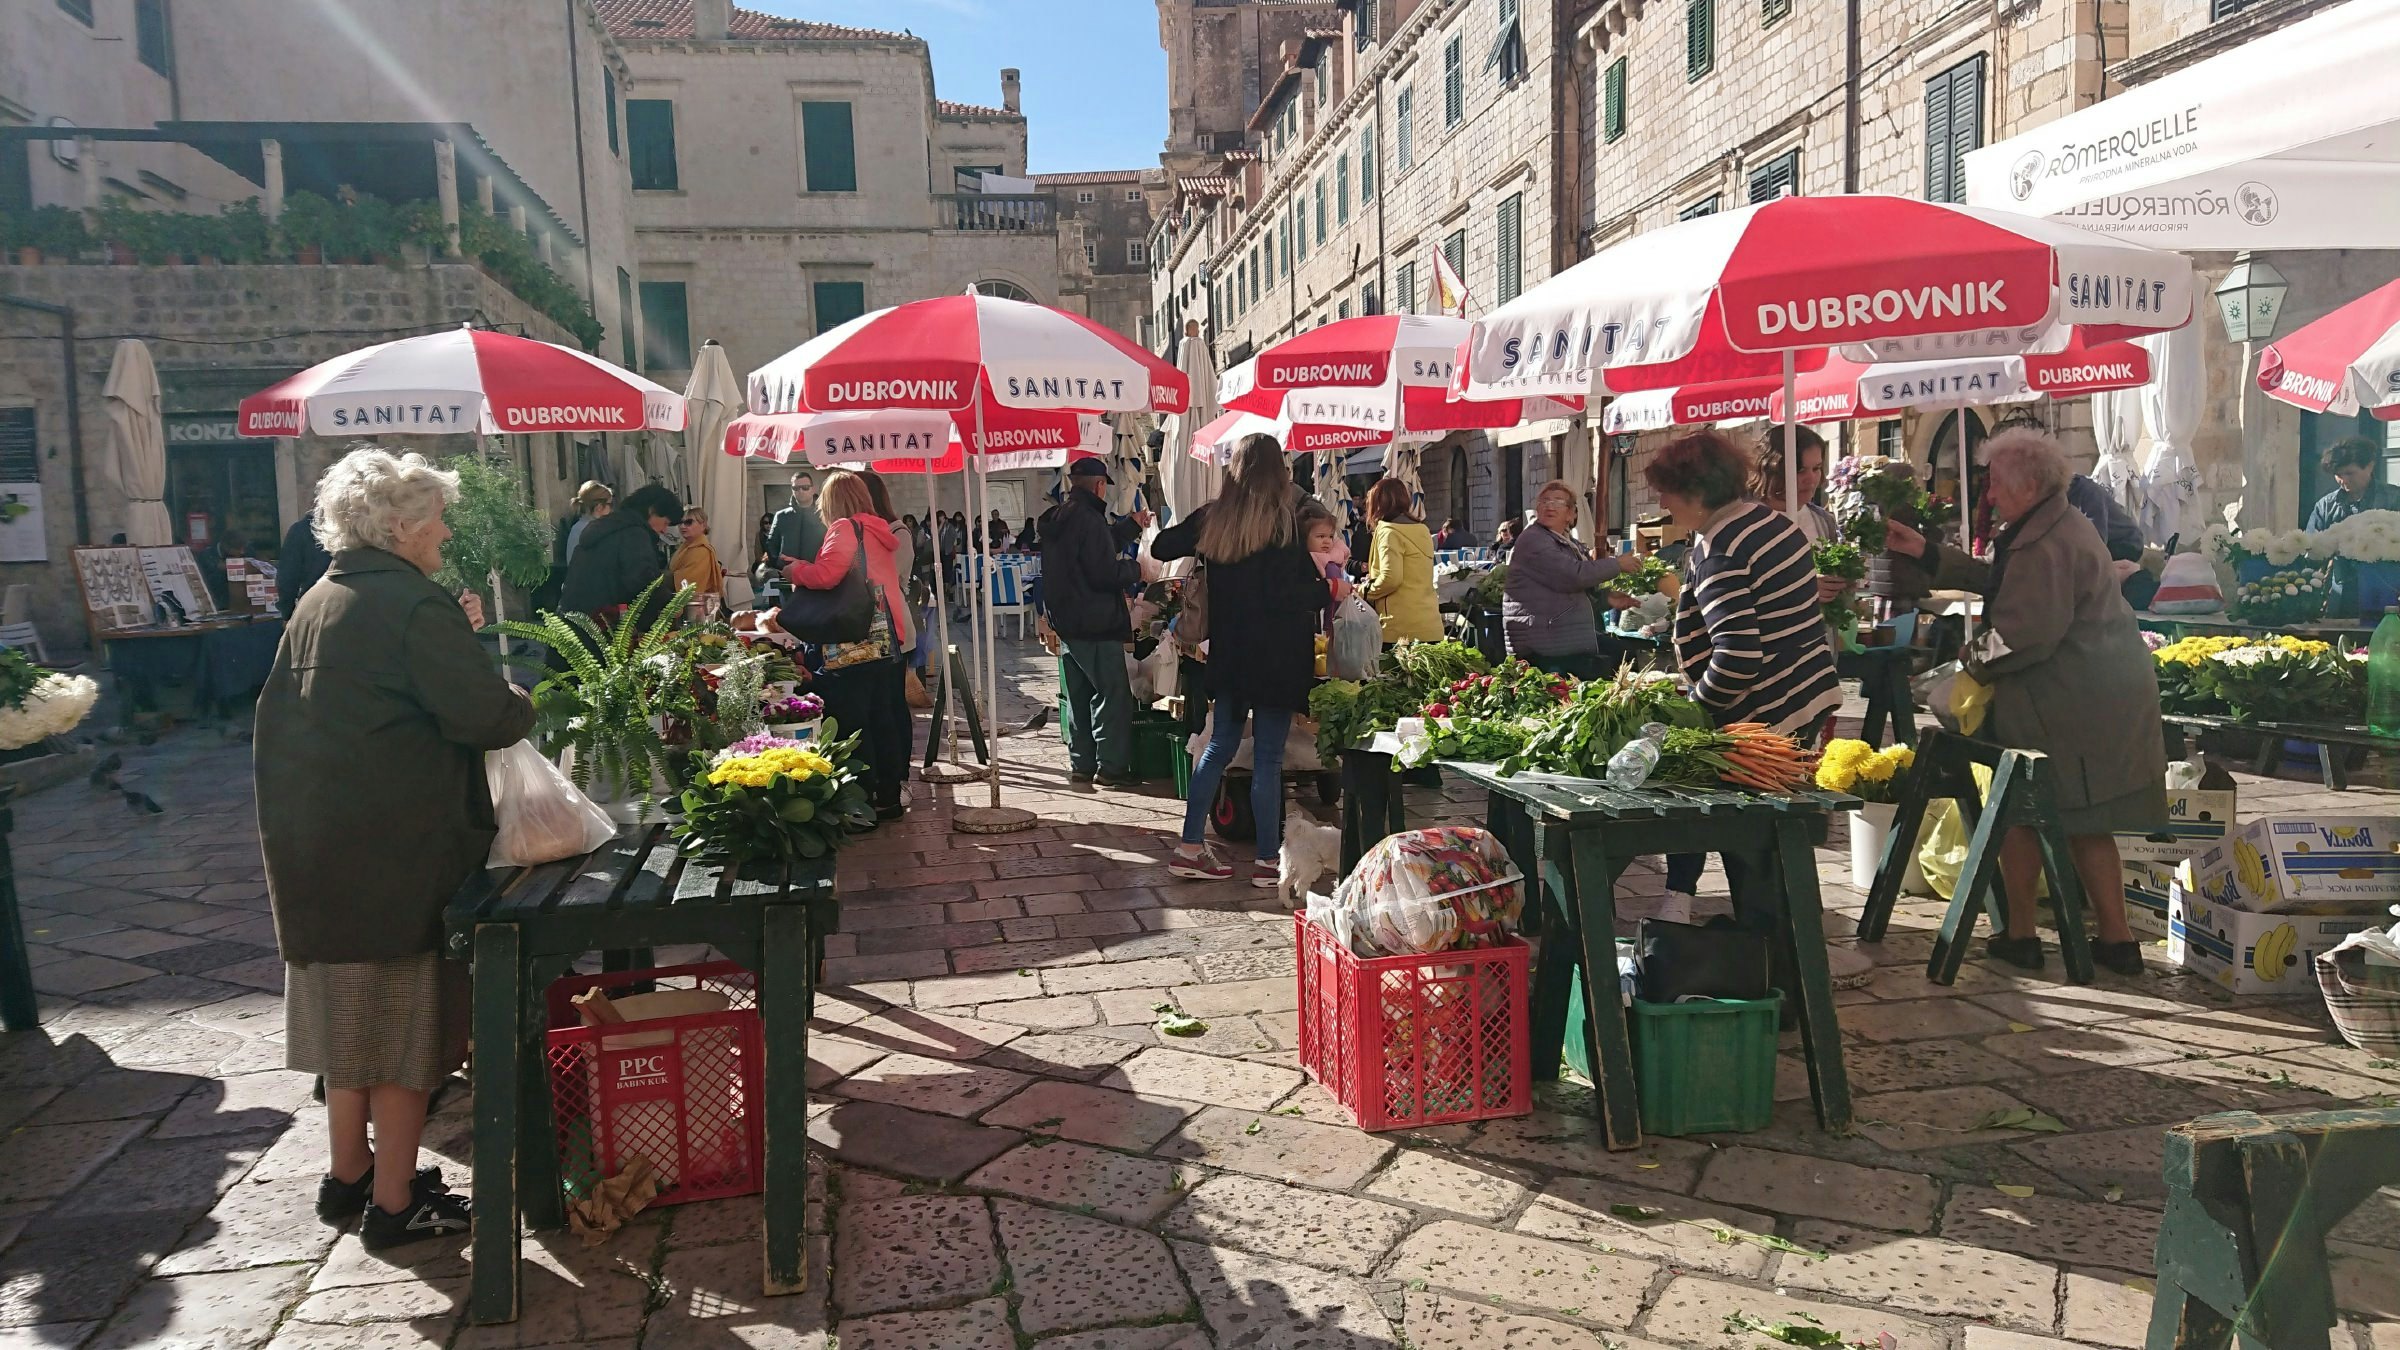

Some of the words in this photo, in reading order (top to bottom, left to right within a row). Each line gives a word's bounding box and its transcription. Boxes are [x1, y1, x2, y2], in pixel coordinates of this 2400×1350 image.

[2079, 167, 2123, 184] PRIRODNA
[2125, 152, 2171, 172] MINERALNA
[2173, 141, 2198, 158] VODA
[2068, 273, 2165, 313] SANITAT
[1758, 279, 2007, 335] DUBROVNIK
[1502, 315, 1672, 369] SANITAT
[1272, 363, 1373, 384] DUBROVNIK
[2038, 362, 2135, 385] DUBROVNIK
[828, 379, 958, 403] DUBROVNIK
[1008, 376, 1124, 400] SANITAT
[1882, 371, 2001, 400] SANITAT
[333, 404, 462, 427] SANITAT
[507, 405, 625, 426] DUBROVNIK
[1614, 407, 1663, 425] SANITAT
[1687, 397, 1772, 419] DUBROVNI
[1783, 393, 1849, 417] UBROVNIK
[825, 432, 934, 455] SANITAT
[1305, 429, 1382, 447] DUBROVNIK
[2320, 827, 2374, 848] BONITA
[2328, 885, 2352, 893] PACK
[619, 1055, 664, 1076] PPC
[616, 1079, 645, 1090] BABIN
[647, 1076, 669, 1086] KUK
